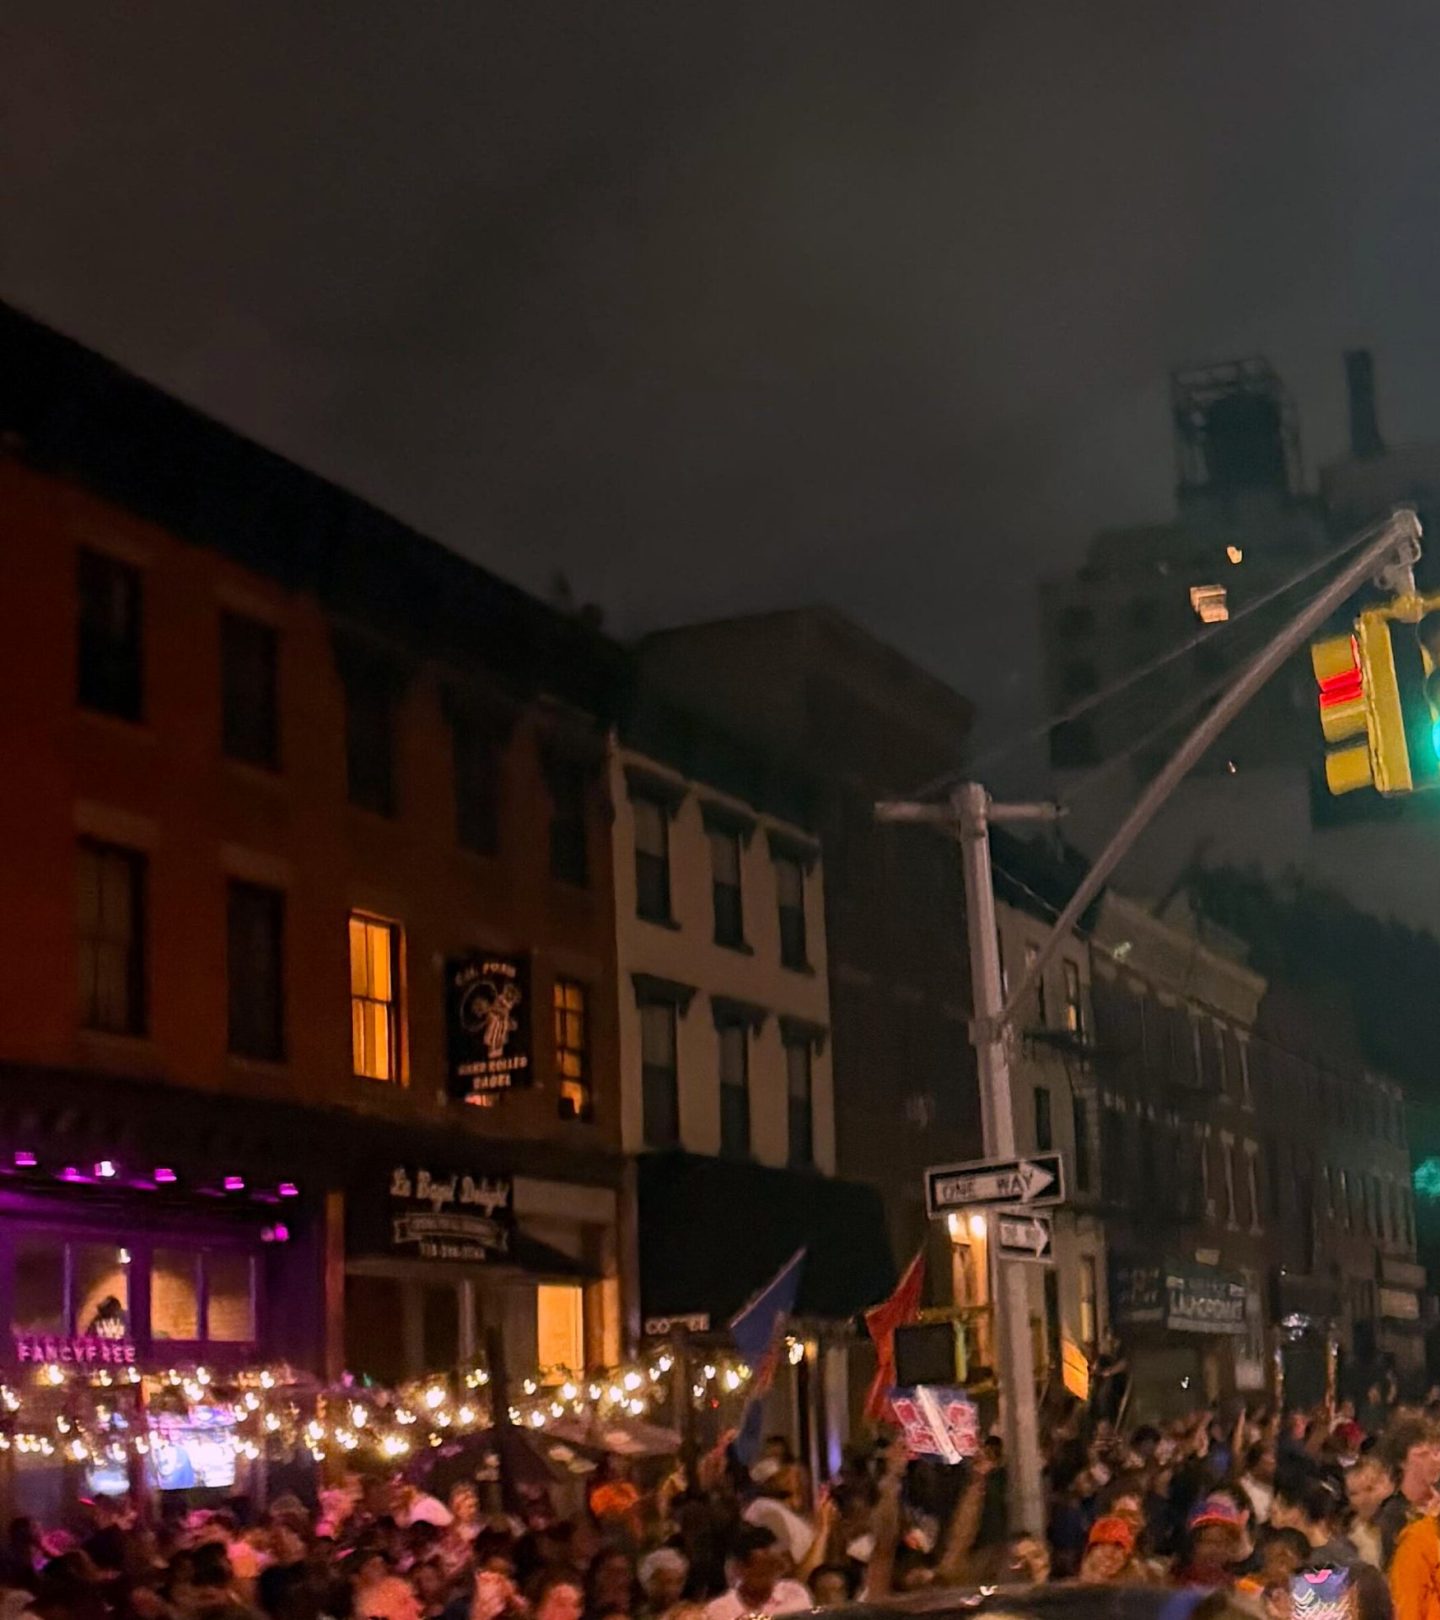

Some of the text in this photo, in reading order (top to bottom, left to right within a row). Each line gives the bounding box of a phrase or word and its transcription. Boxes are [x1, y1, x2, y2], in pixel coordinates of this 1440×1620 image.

[942, 1171, 1035, 1201] ONE WAY
[18, 1342, 136, 1363] FANCYFREE
